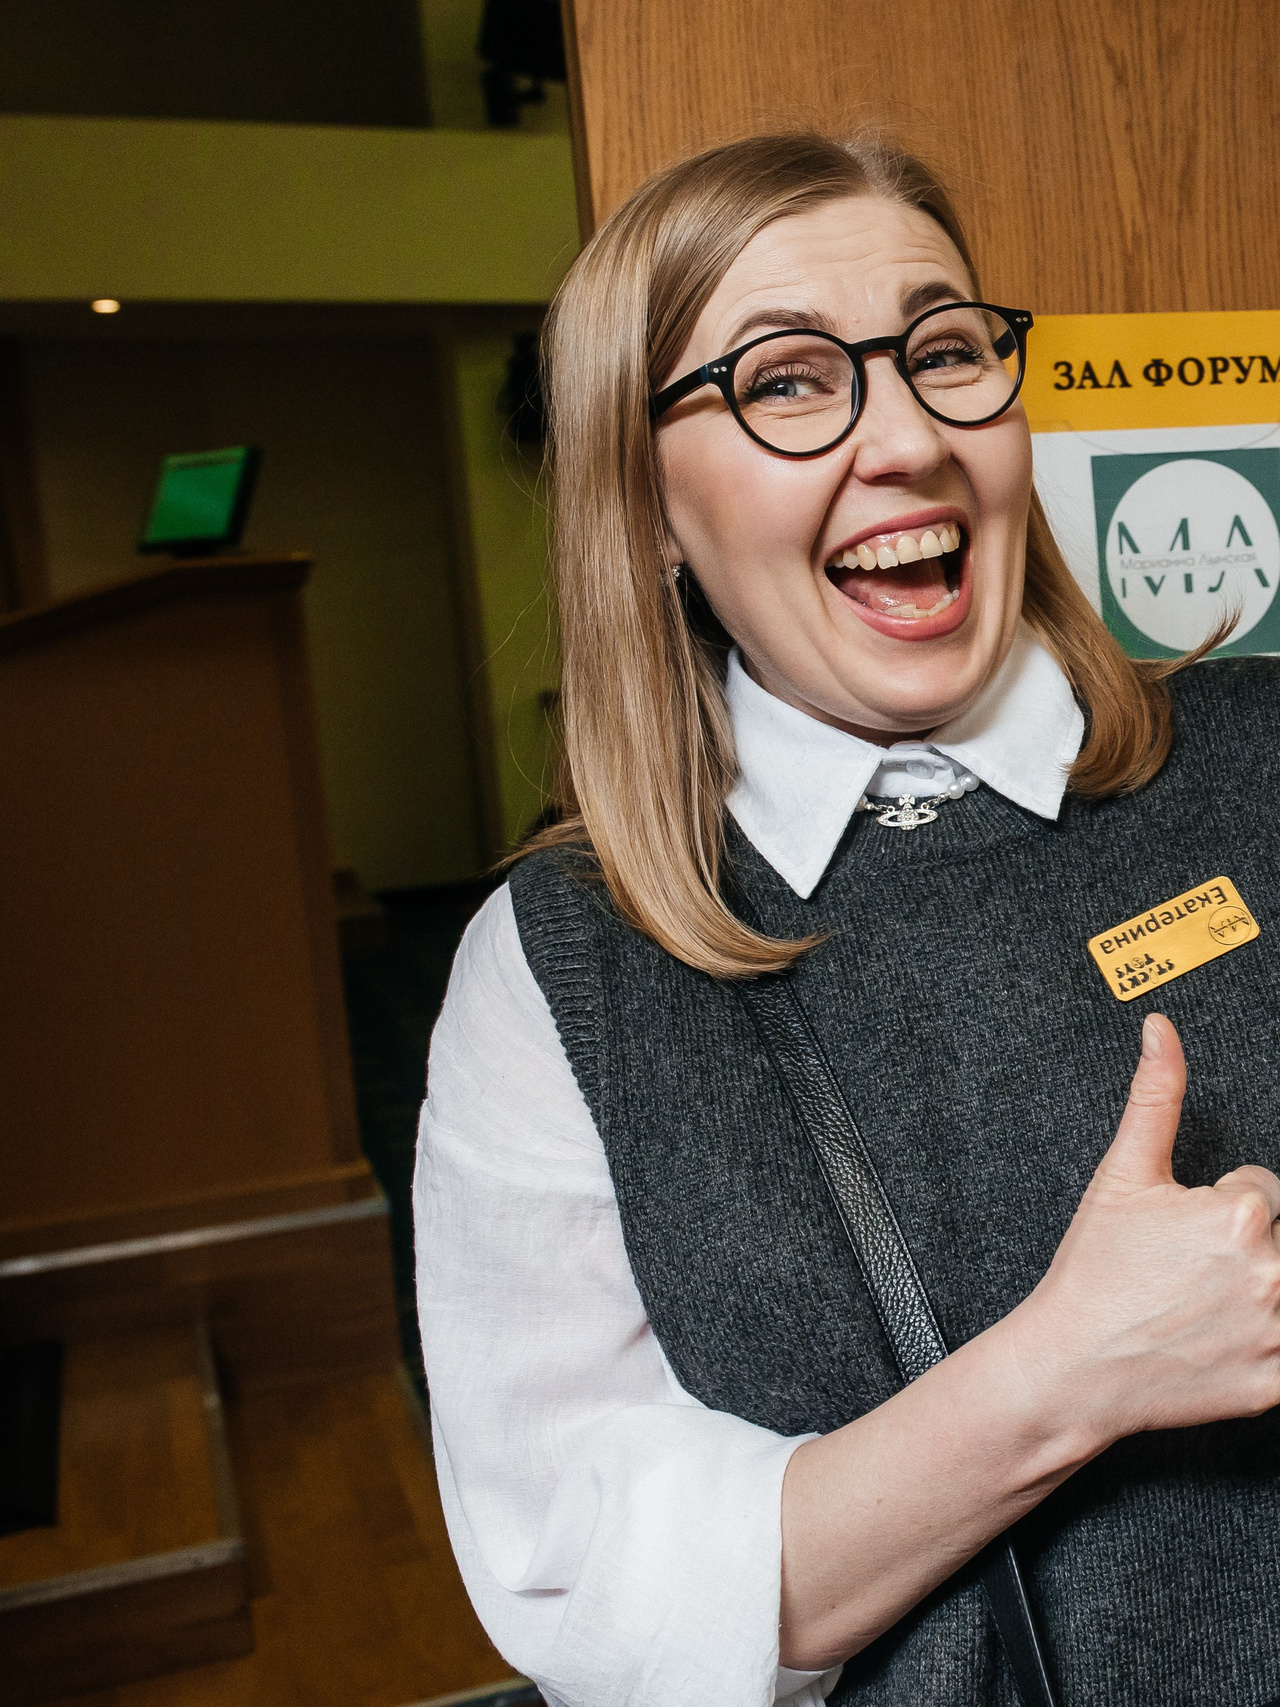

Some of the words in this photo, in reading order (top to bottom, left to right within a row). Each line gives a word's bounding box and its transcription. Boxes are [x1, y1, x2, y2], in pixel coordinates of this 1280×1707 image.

[1053, 359, 1132, 390] ЗАЛ
[1120, 557, 1195, 571] Марианна
[1099, 885, 1229, 955] Екатерина
